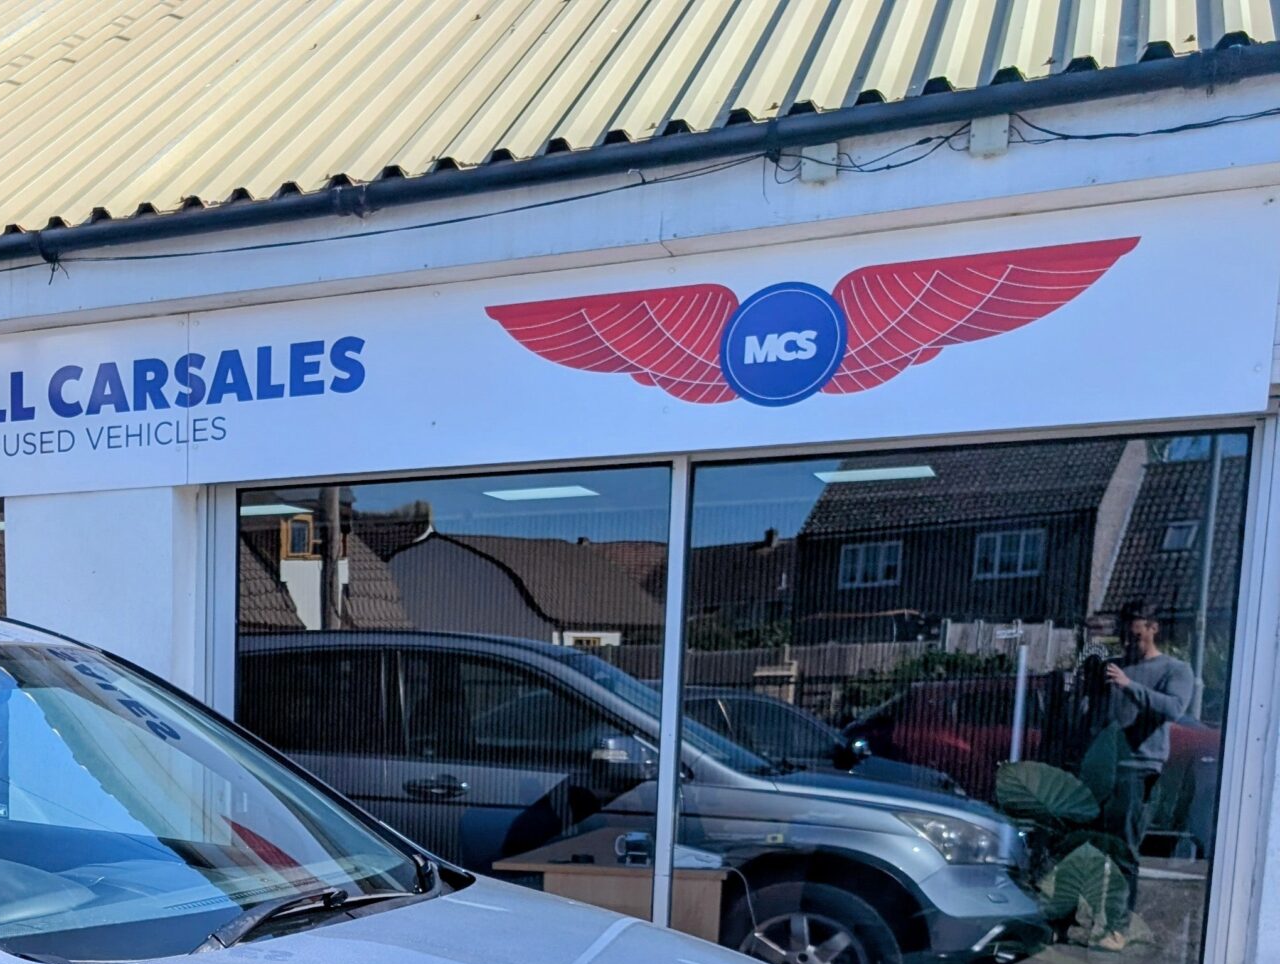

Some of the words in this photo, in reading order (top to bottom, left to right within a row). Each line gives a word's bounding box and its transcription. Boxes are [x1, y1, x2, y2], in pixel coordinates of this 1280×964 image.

[743, 329, 818, 365] MCS
[47, 336, 366, 419] CARSALES
[3, 429, 76, 457] USED
[85, 417, 227, 451] VEHICLES
